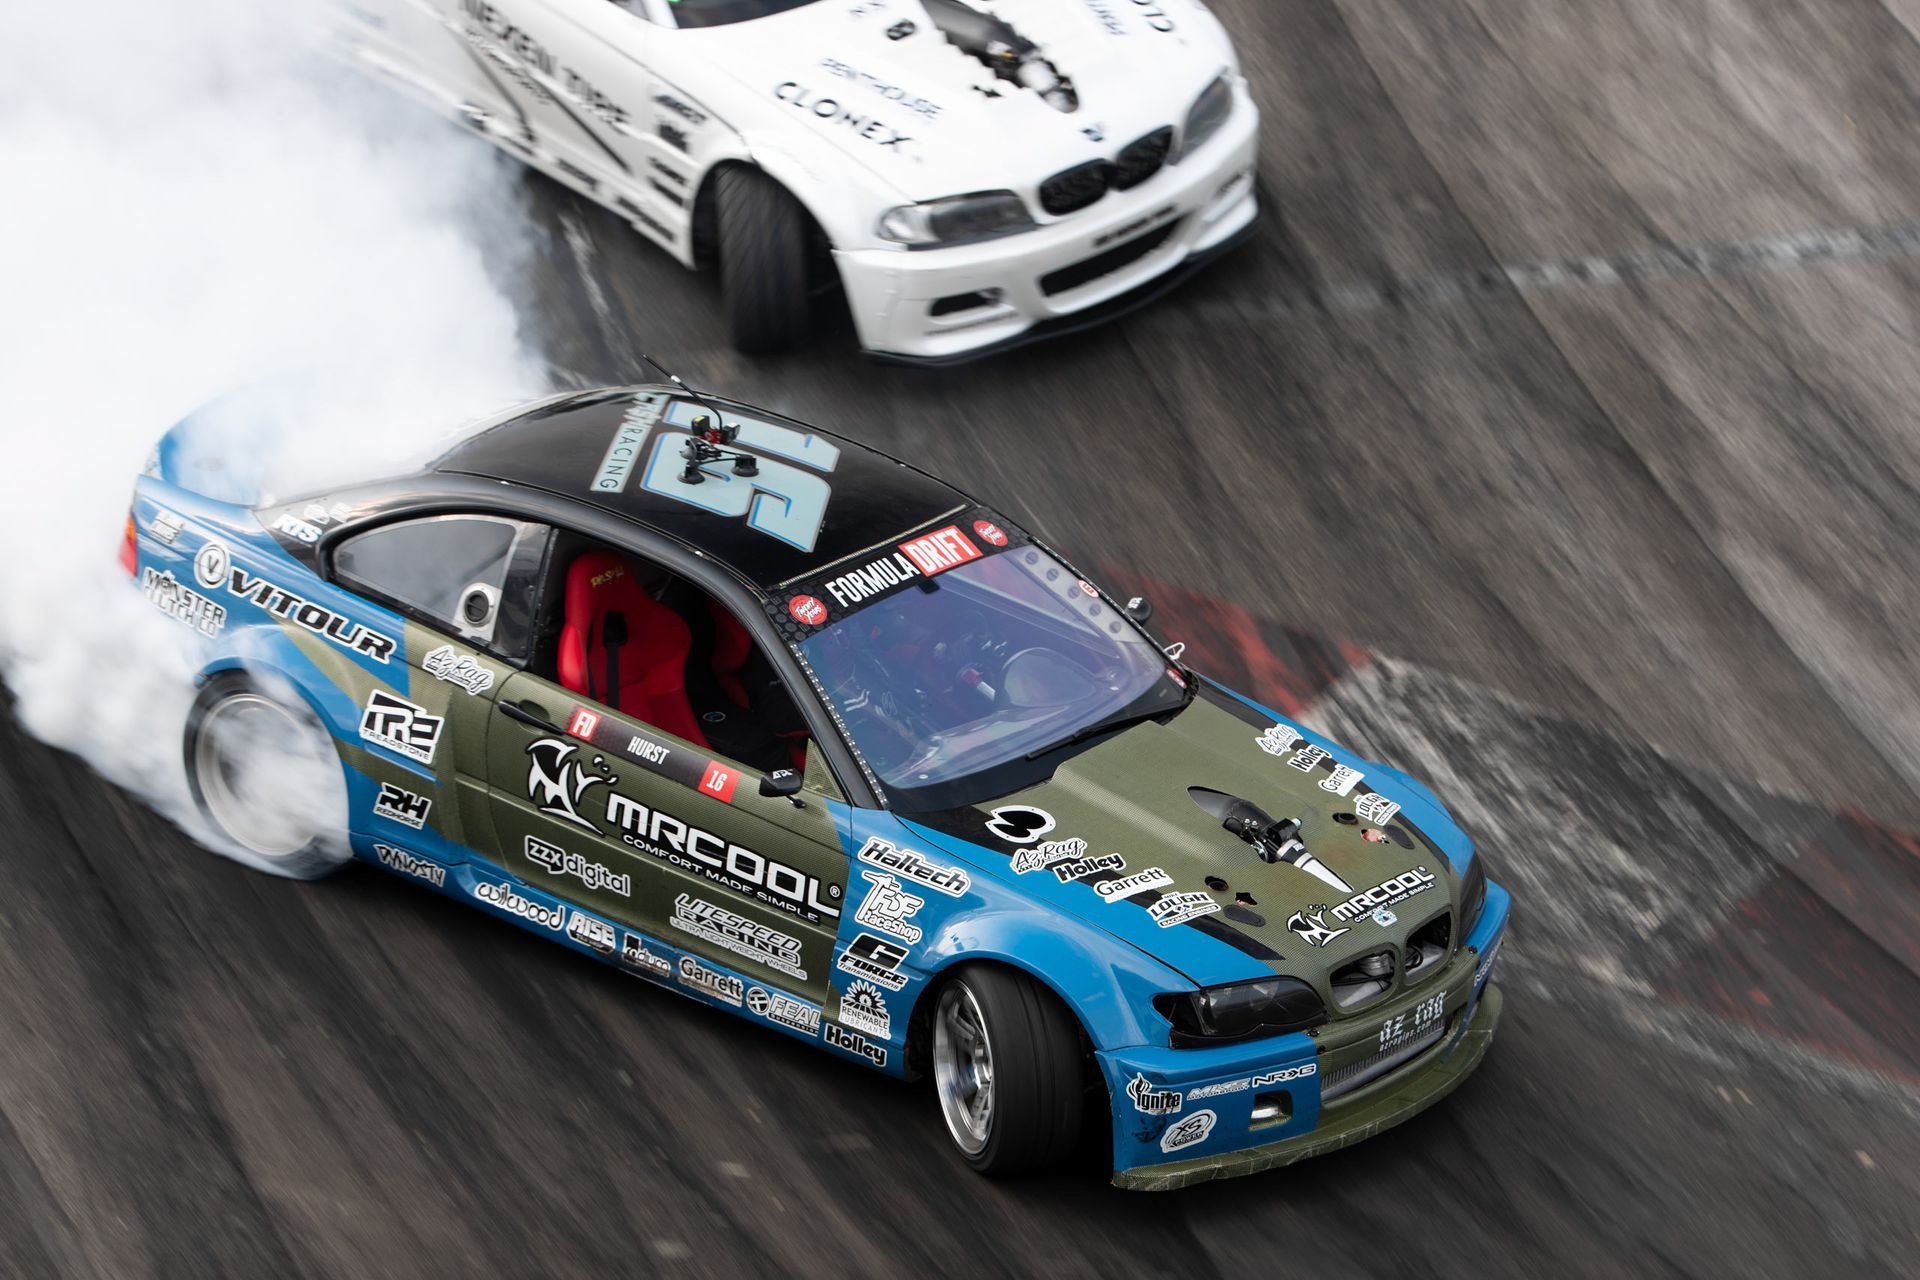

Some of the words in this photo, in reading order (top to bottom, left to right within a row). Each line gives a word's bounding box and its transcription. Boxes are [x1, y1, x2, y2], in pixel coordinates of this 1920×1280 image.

[775, 82, 913, 153] CLONEX
[600, 427, 644, 490] RACING
[825, 552, 920, 607] FORMULA
[904, 527, 977, 573] DRIFT
[231, 570, 394, 662] VITOUR
[363, 729, 430, 760] TREADSTONE
[572, 711, 597, 738] FD
[627, 736, 670, 764] HURST
[706, 769, 727, 792] 16
[376, 806, 421, 828] REDHORSE
[379, 785, 428, 820] RH
[623, 835, 702, 873] COMFORT
[706, 869, 753, 897] MADE
[757, 891, 819, 922] SIMPLE
[863, 842, 966, 892] Haltech
[1055, 855, 1124, 881] Holley
[1096, 868, 1166, 896] Garrett
[478, 883, 563, 930] wilwood
[1151, 894, 1209, 917] LOUGH
[1389, 892, 1409, 905] MADE
[1409, 882, 1434, 895] SIMPLE
[570, 914, 615, 949] RISE
[677, 895, 800, 952] LITESPEED
[679, 907, 800, 965] RACING
[866, 910, 921, 943] RaceShop
[681, 958, 743, 998] Garrett
[768, 959, 807, 979] WHEELS
[839, 963, 899, 990] Transmissions
[840, 955, 906, 985] FORCE
[769, 995, 821, 1028] FEAL
[840, 1015, 889, 1037] LUBRICANTS
[842, 1006, 888, 1030] RENEWABLE
[826, 1025, 886, 1066] Holley
[1176, 1119, 1202, 1137] XS
